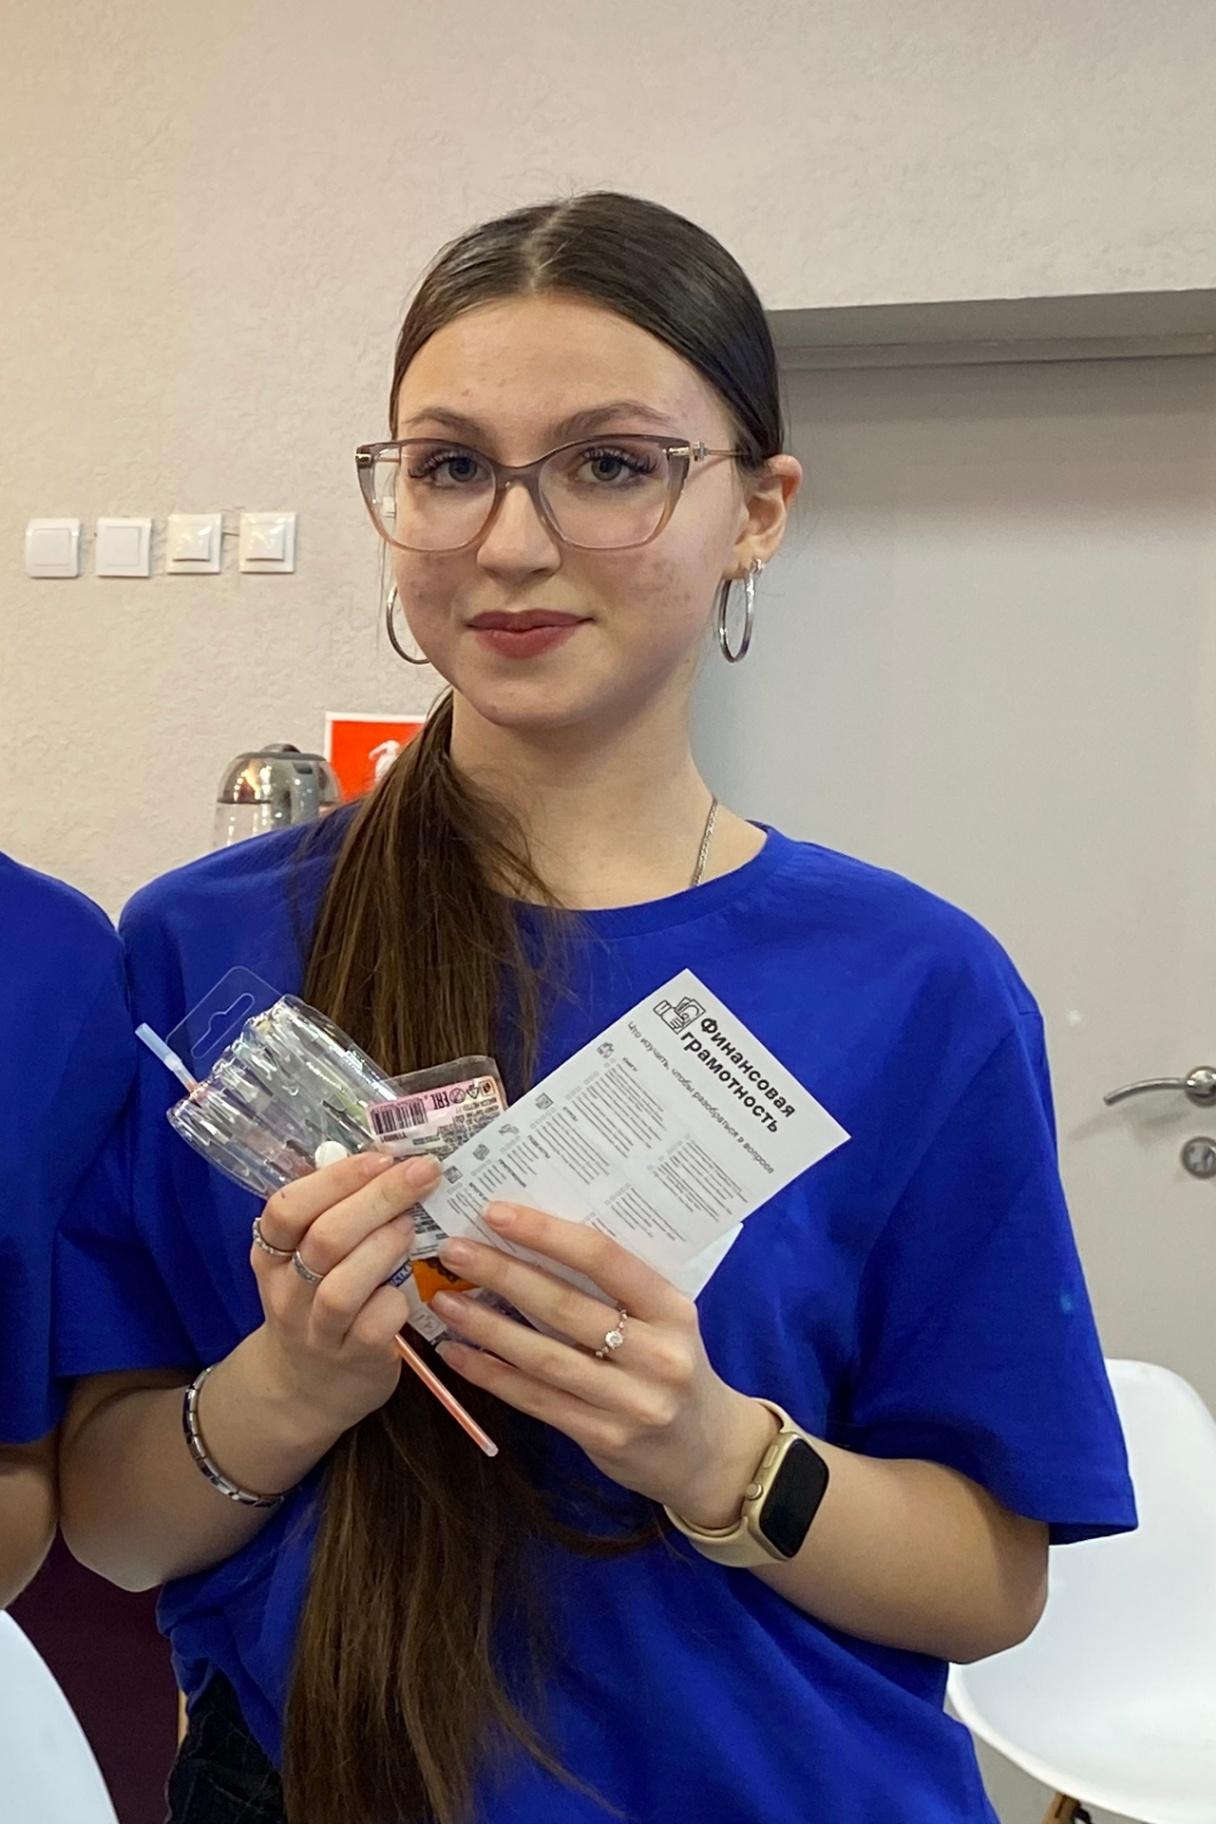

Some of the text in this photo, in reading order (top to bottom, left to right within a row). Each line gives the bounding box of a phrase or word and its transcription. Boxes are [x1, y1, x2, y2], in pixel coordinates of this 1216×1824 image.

[625, 1019, 645, 1039] Что
[670, 1066, 696, 1093] чтобы
[691, 1090, 739, 1138] разобраться
[679, 1030, 780, 1134] грамотность
[697, 1016, 797, 1118] Финансовая
